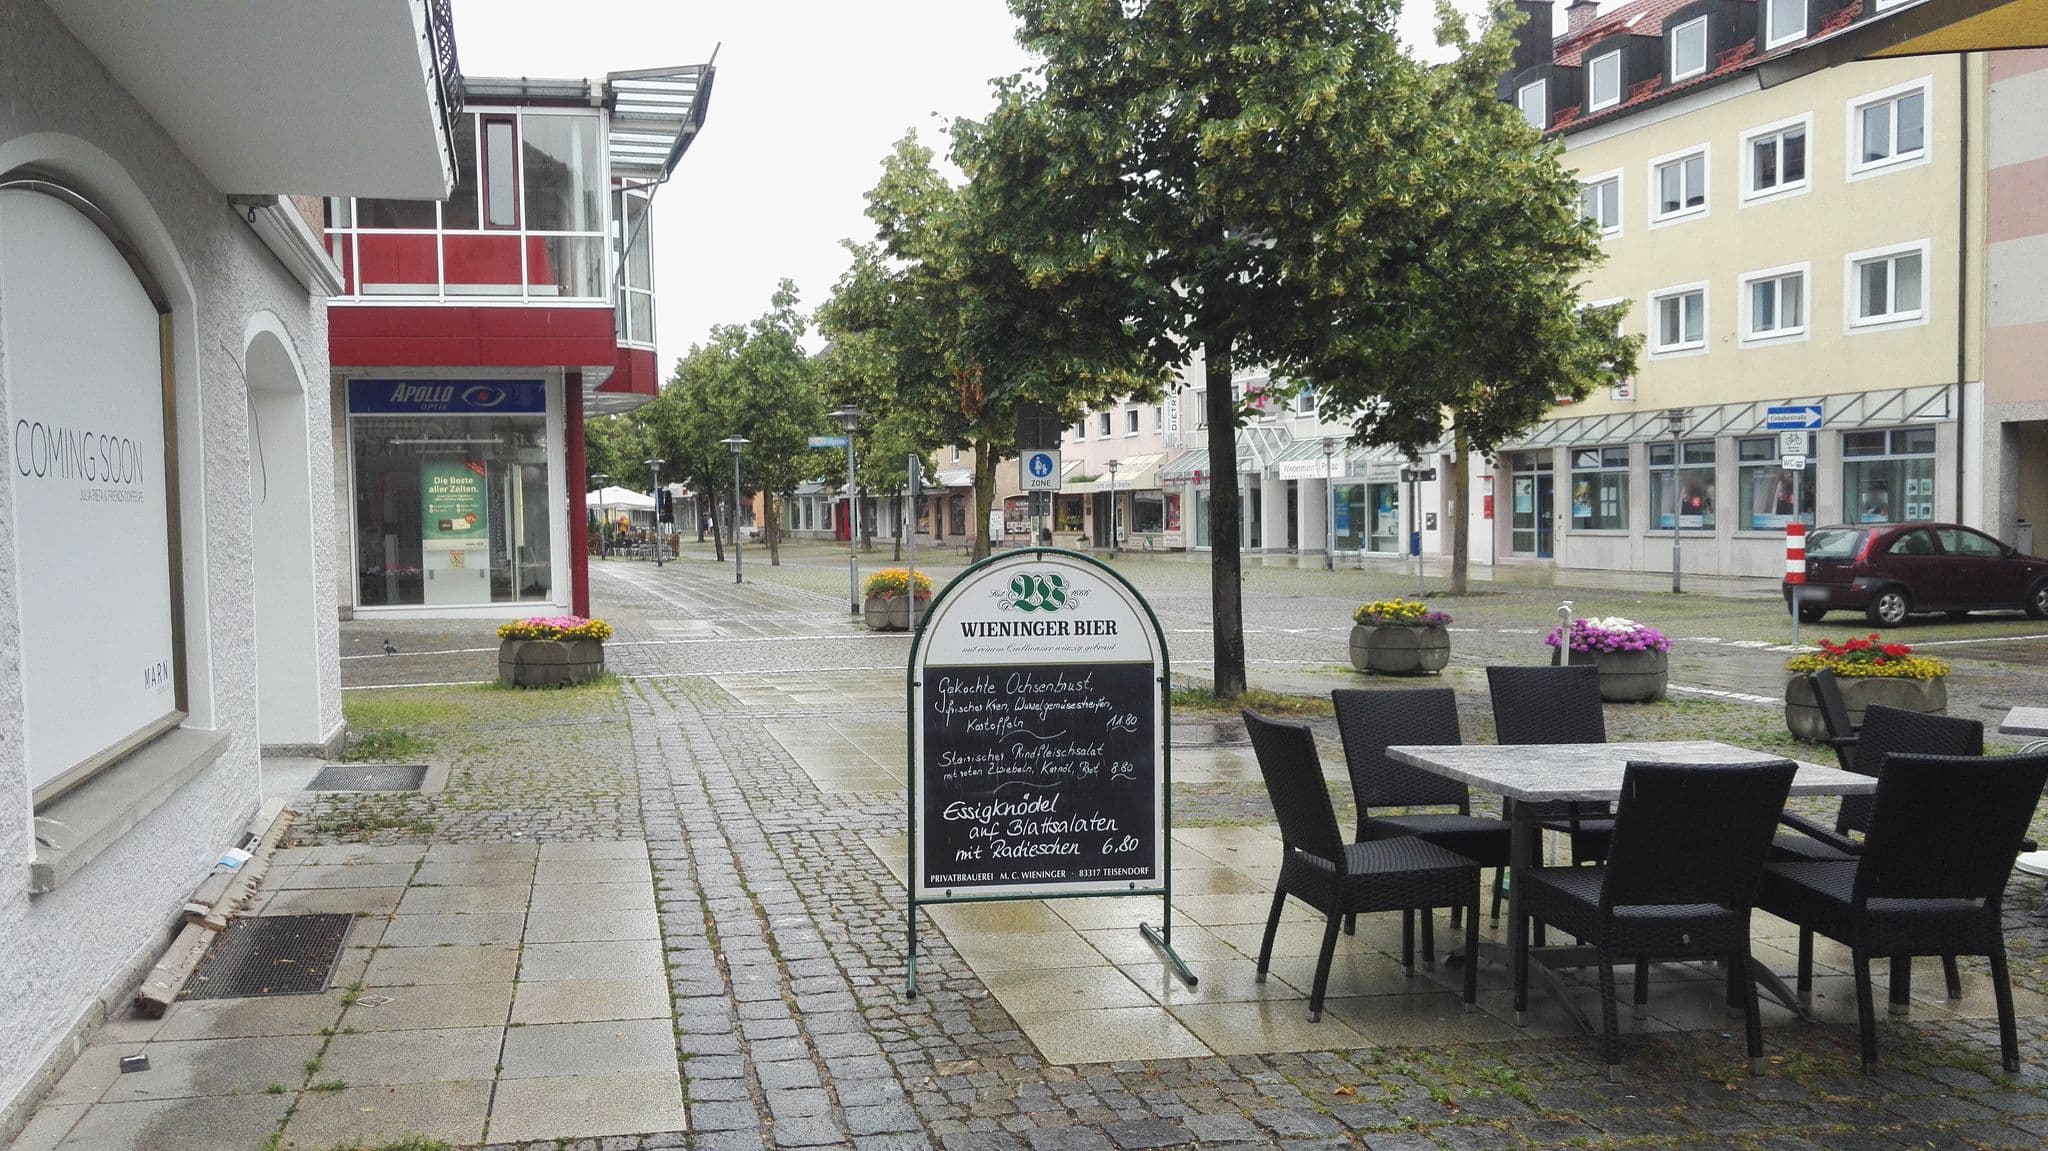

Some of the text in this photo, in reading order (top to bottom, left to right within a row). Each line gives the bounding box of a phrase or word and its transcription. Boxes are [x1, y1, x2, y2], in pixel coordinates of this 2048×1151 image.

[390, 383, 454, 402] APOLLO
[421, 402, 448, 410] OPTIK
[16, 419, 144, 484] COMING SOON
[429, 485, 479, 493] aller Zeiten.
[434, 476, 474, 485] Die Beste
[1071, 589, 1091, 597] 1666
[961, 620, 1118, 638] WIENINGER BIER
[144, 660, 168, 690] MARN
[943, 792, 1060, 823] Essigknödel
[969, 811, 1119, 840] auf Blattsalaten
[955, 835, 1139, 861] mit Radieschen 6.80
[930, 867, 1149, 883] PRIVATBRAUEREI M. C. WIENINGER 83317 TEISENDORF
